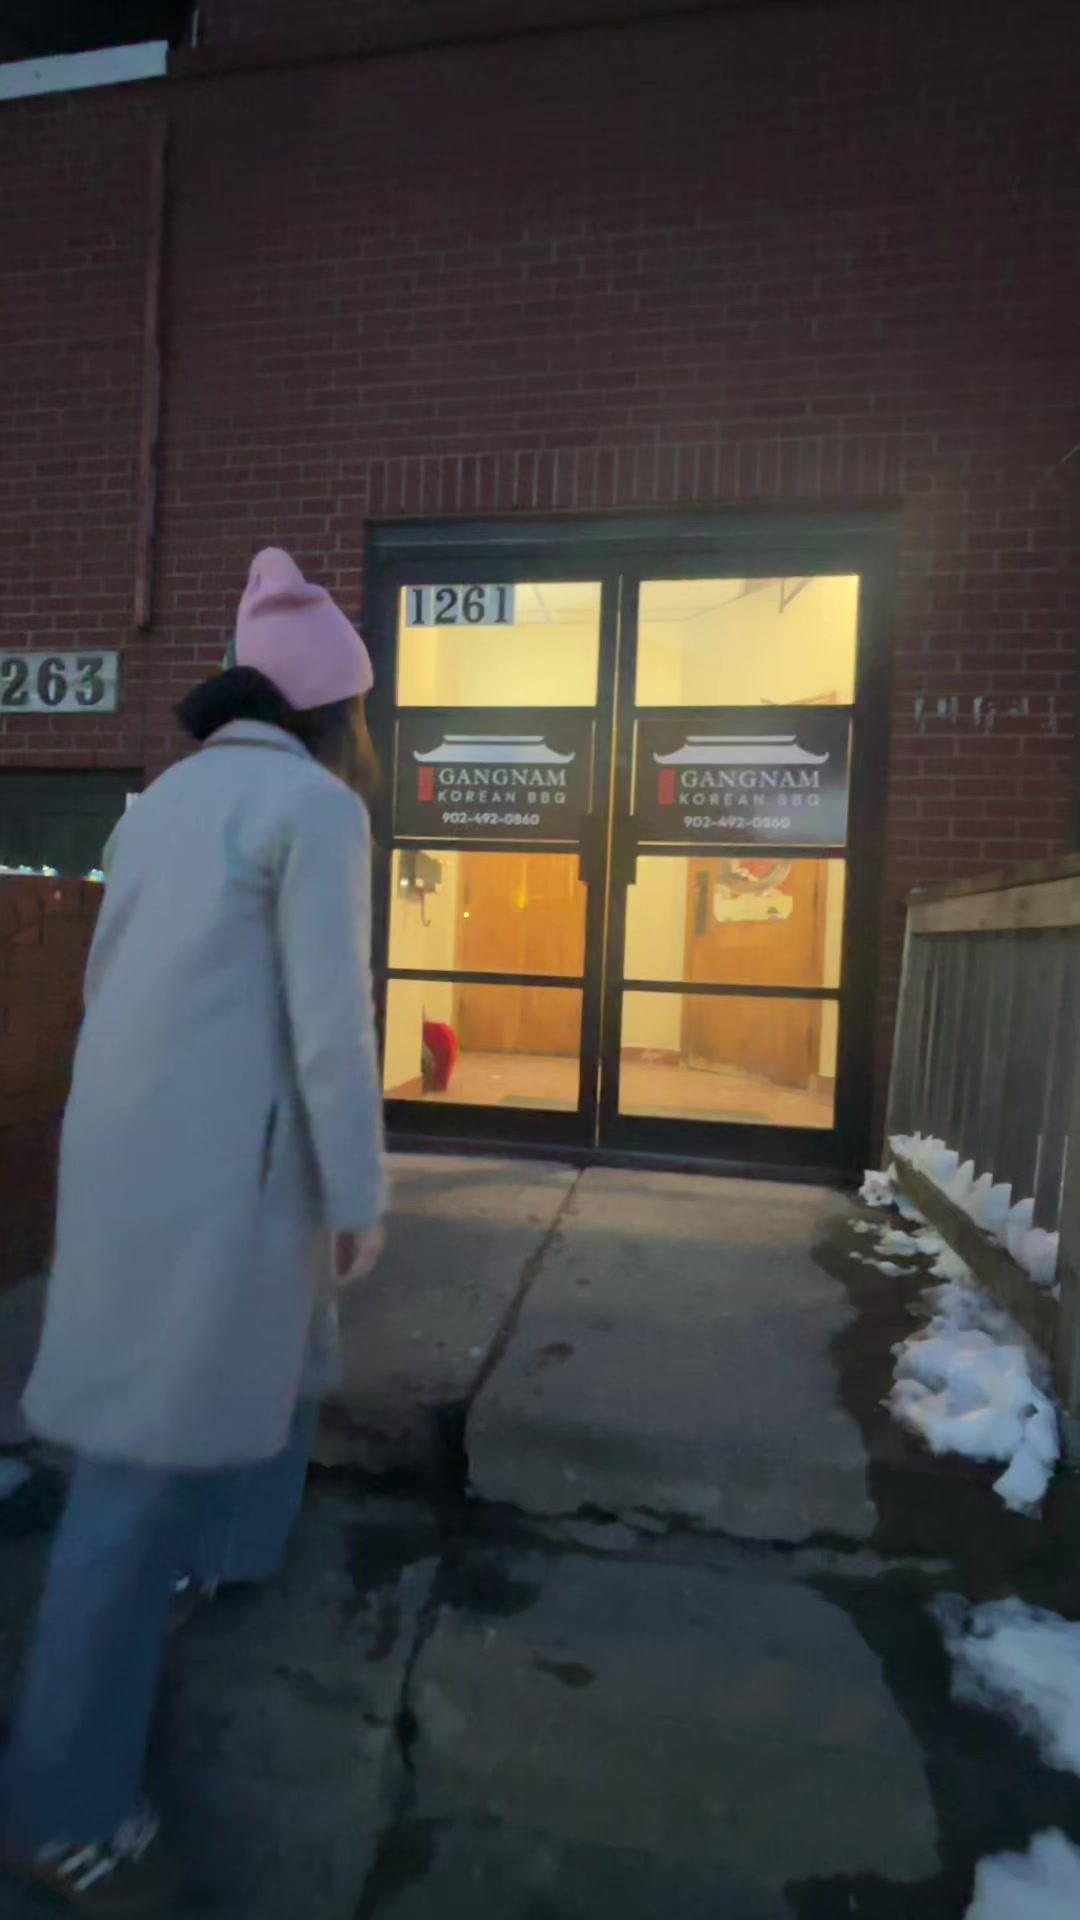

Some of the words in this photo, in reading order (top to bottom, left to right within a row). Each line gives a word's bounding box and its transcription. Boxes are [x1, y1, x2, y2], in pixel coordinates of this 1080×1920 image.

[412, 586, 507, 625] 1261
[438, 767, 567, 786] GANGNAM
[680, 769, 820, 788] GANGNAM
[437, 789, 517, 803] KOREAN
[527, 790, 567, 804] BBQ
[679, 792, 765, 806] KOREAN
[778, 793, 820, 807] BBQ
[441, 811, 540, 826] 902-492-0860
